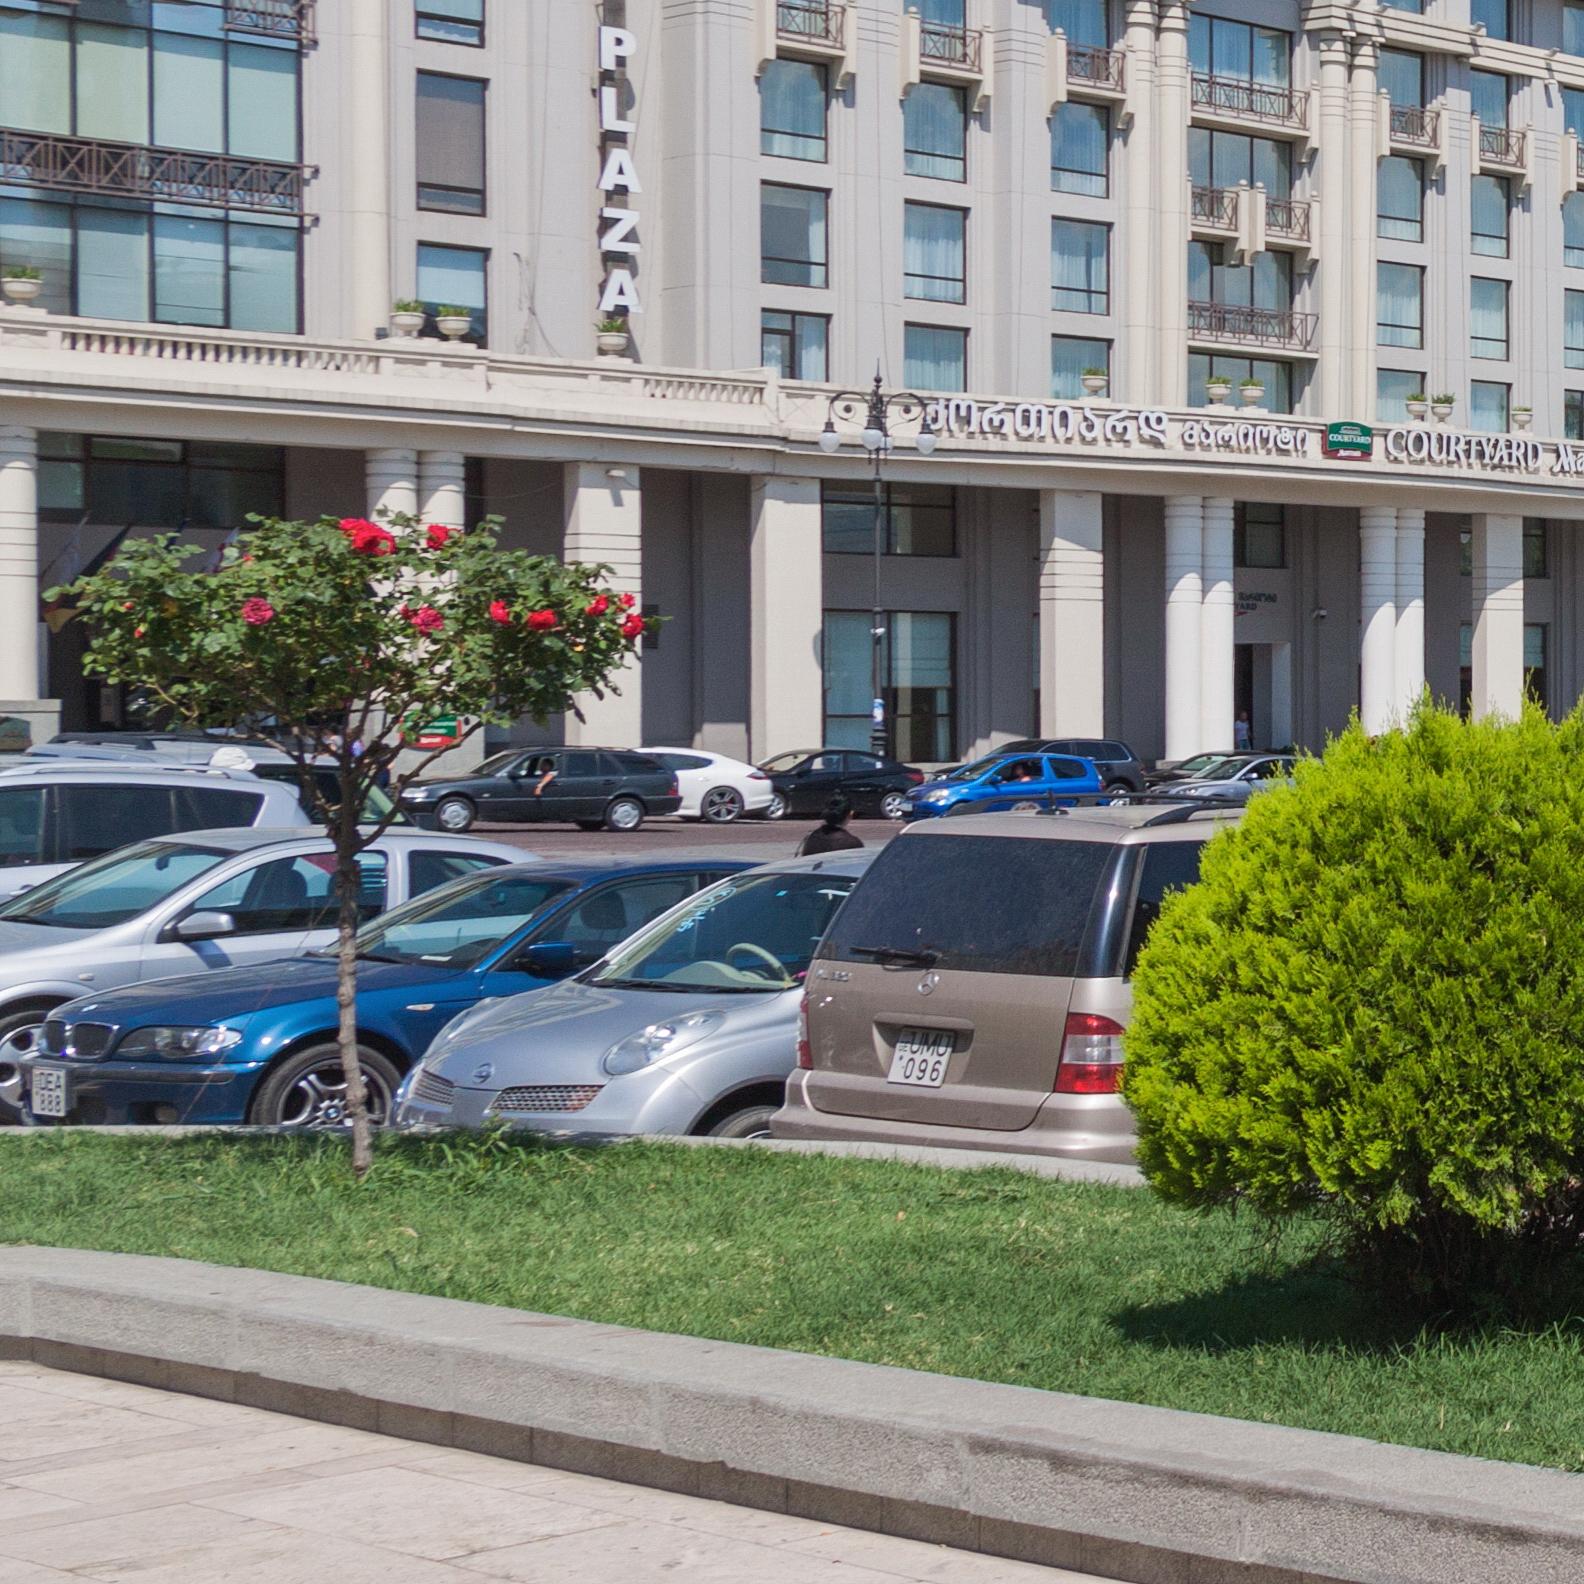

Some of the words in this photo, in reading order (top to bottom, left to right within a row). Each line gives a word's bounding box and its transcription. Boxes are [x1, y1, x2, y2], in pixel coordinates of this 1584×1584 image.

[598, 24, 643, 314] PLAZA
[1182, 421, 1310, 451] მარიოტი
[1386, 429, 1544, 467] COURTYARD
[909, 1031, 953, 1057] UMU
[903, 1057, 942, 1083] 096
